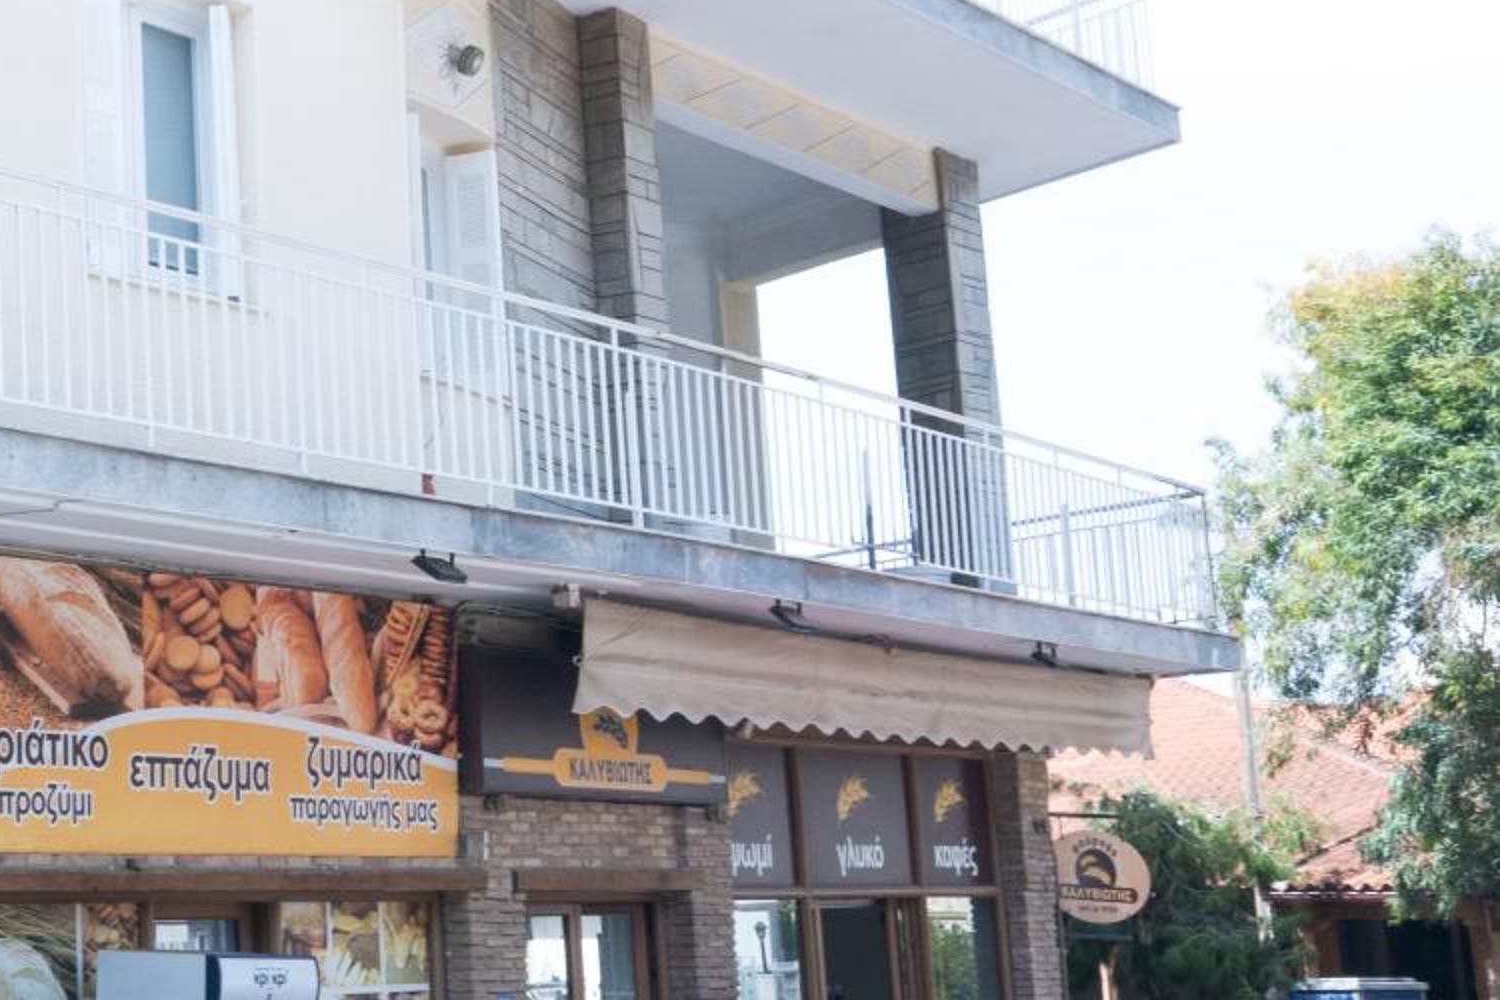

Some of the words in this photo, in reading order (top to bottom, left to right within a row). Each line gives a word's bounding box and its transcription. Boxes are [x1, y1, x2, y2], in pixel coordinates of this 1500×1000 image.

[130, 746, 271, 801] επτάζυμα
[307, 737, 422, 790] ζυμαρικά
[569, 758, 652, 784] ΚΑΛΥΒΙΩΤΗΣ
[289, 795, 402, 829] παραγωγής
[406, 799, 438, 830] μας
[933, 838, 979, 877] καφές
